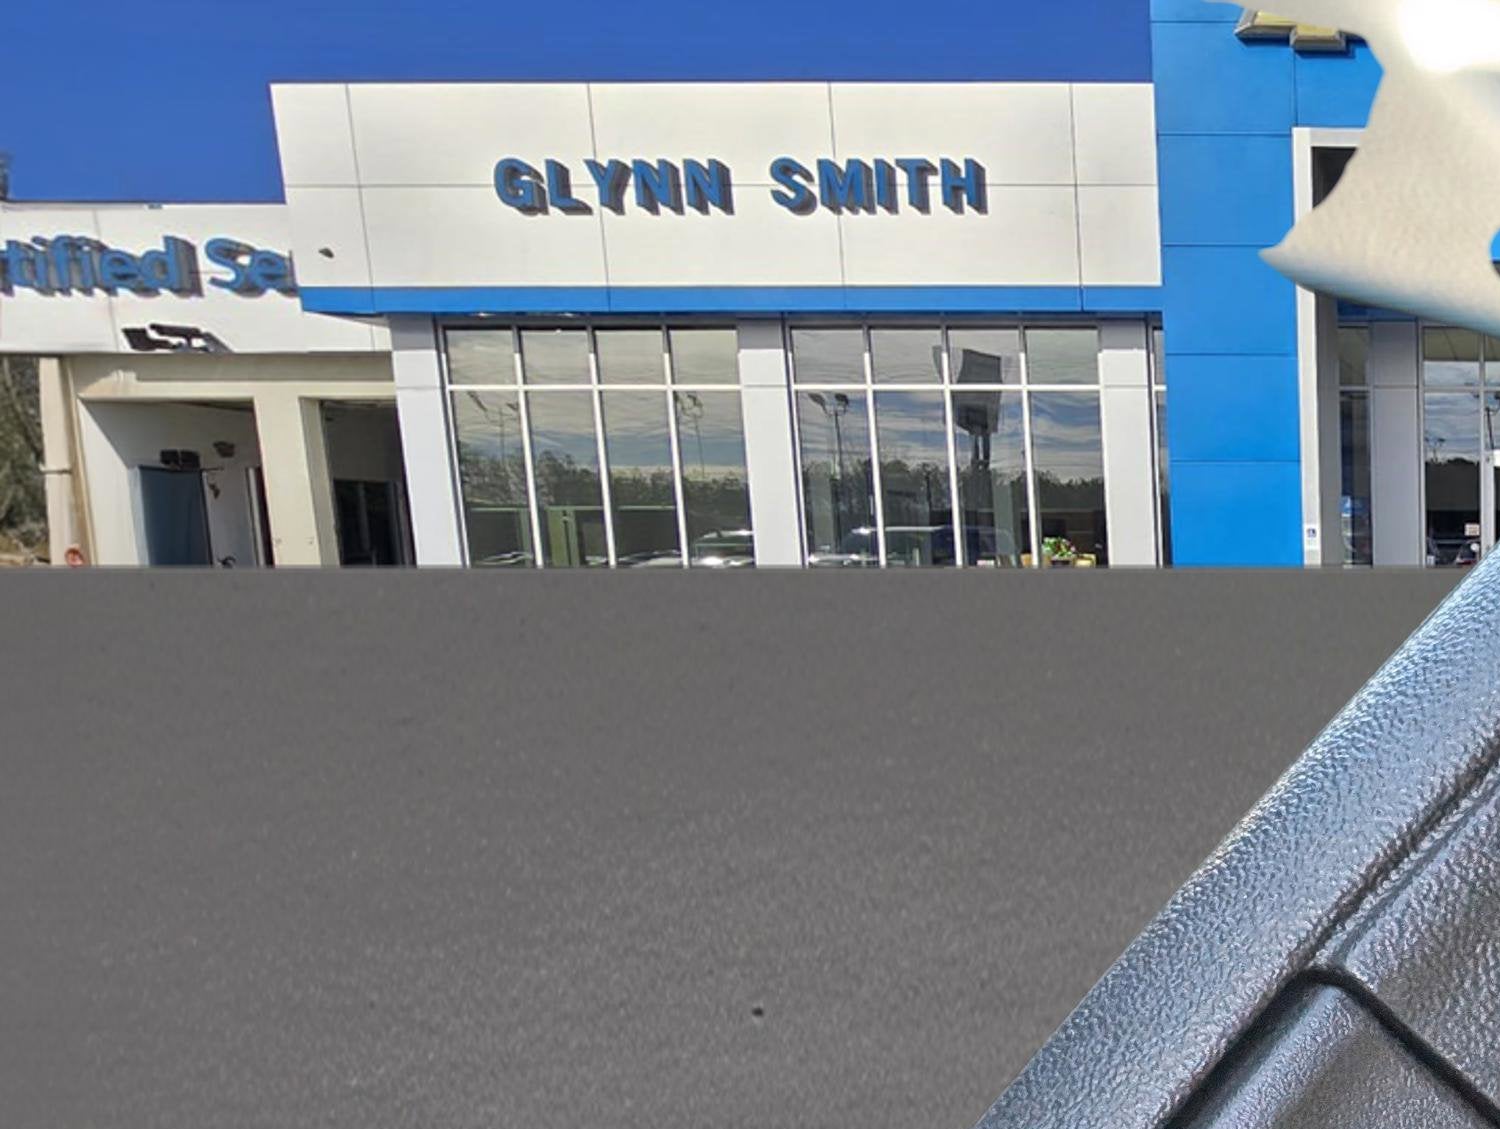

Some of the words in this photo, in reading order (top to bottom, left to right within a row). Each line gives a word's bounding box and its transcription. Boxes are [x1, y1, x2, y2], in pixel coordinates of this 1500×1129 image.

[494, 157, 734, 215] GLYNN
[769, 157, 988, 215] SMITH
[0, 235, 203, 297] tified
[204, 237, 299, 298] Se
